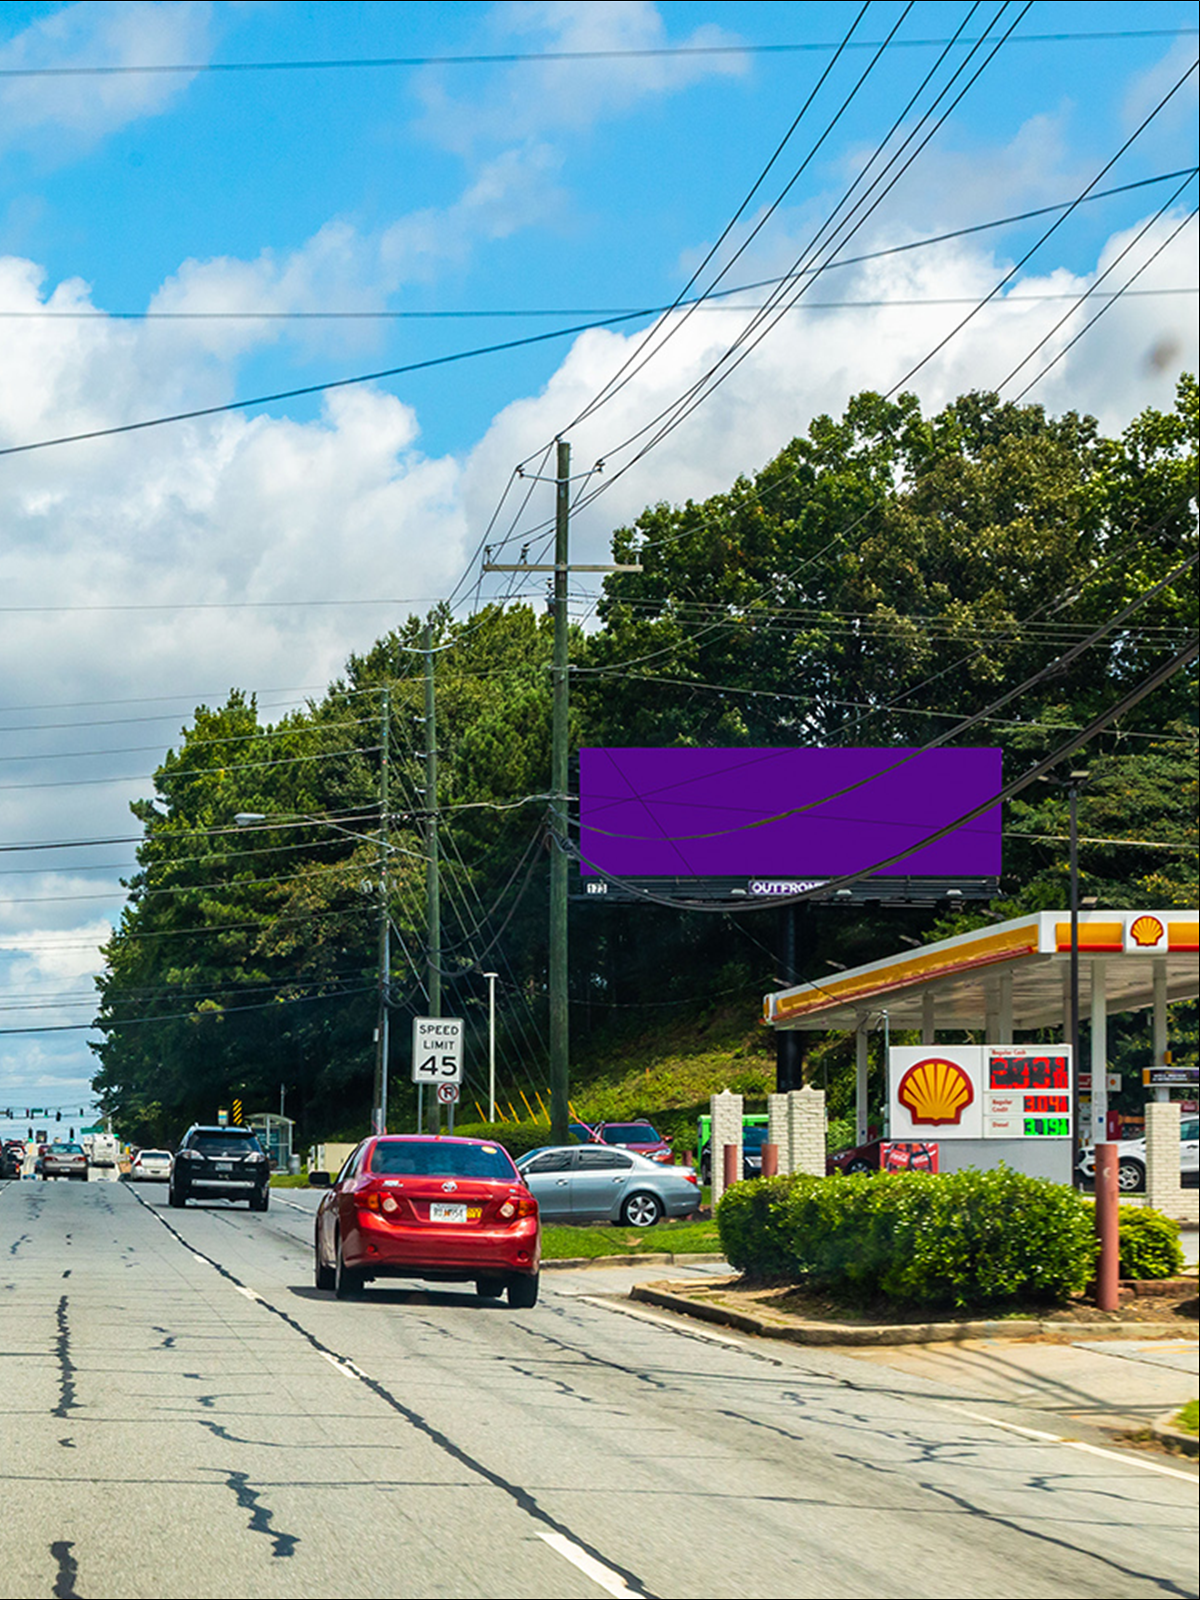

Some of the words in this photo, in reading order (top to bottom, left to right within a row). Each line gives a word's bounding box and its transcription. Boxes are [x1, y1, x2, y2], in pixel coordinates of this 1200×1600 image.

[752, 882, 828, 894] OUTFRON
[419, 1025, 459, 1036] SPEED
[423, 1040, 455, 1050] LIMIT
[419, 1055, 457, 1076] 45
